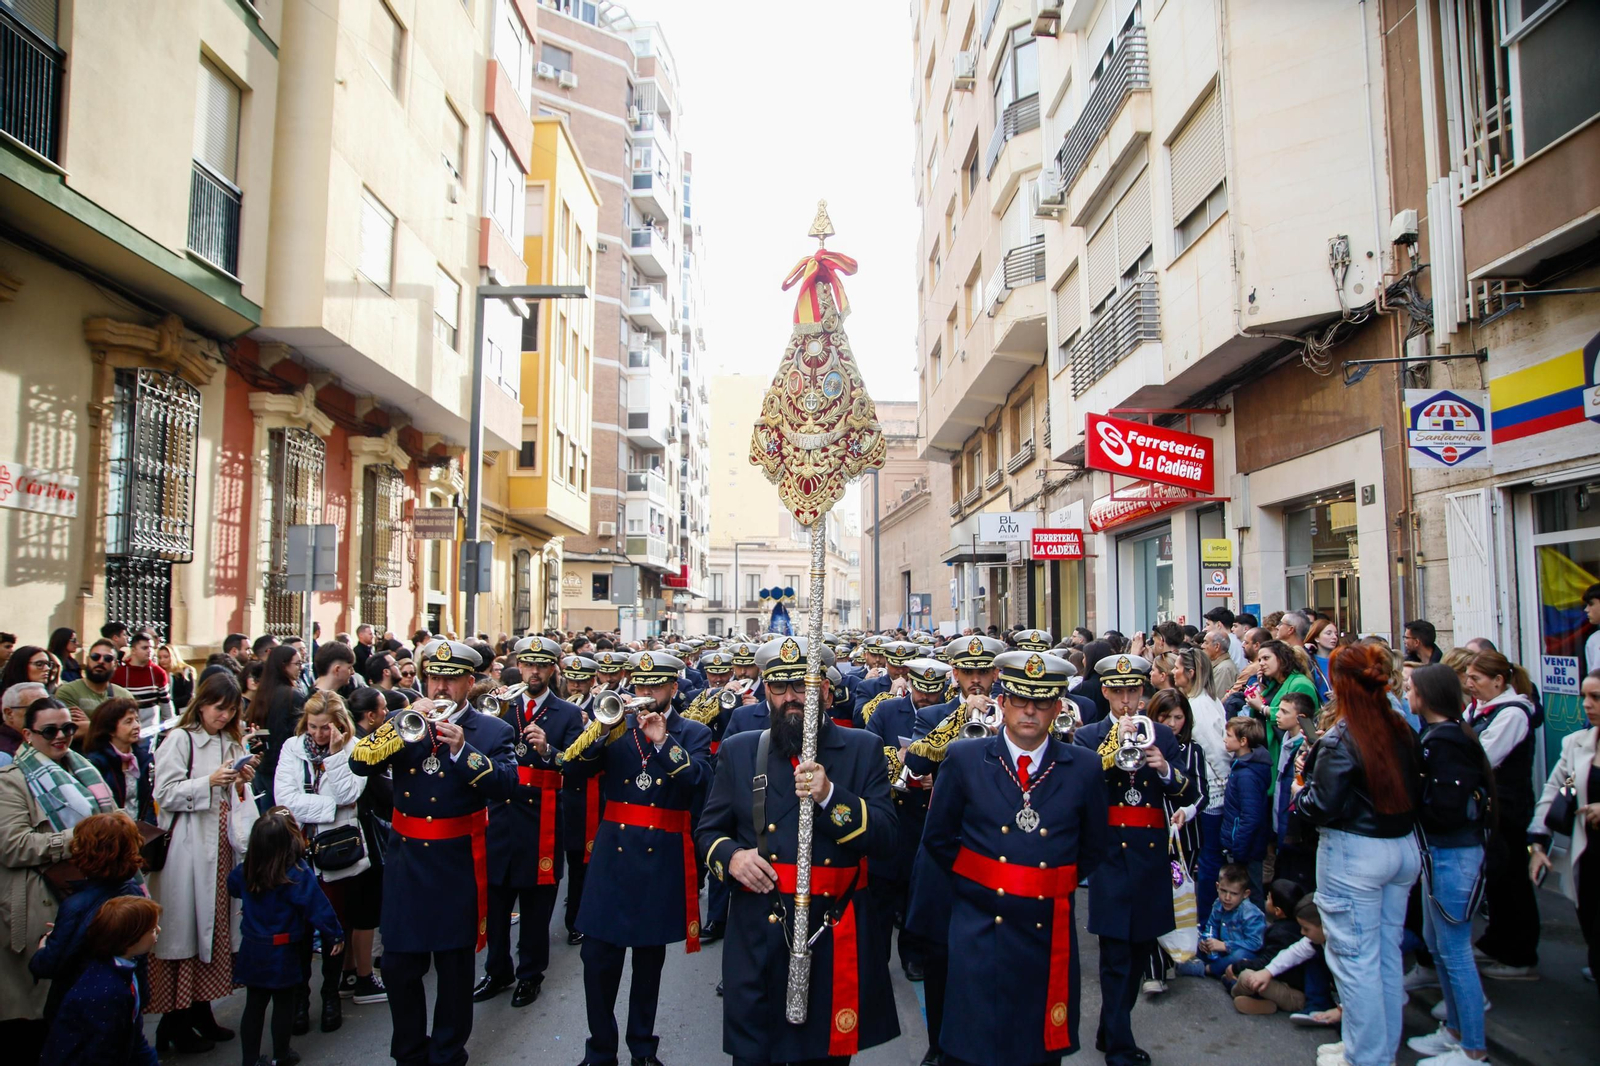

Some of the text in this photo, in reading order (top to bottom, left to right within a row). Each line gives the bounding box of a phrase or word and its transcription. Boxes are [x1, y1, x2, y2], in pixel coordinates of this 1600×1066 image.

[1415, 431, 1482, 442] Santarrita
[1127, 430, 1206, 459] Ferretería
[1139, 451, 1202, 480] La Cadena
[1181, 460, 1203, 468] centro
[15, 475, 75, 501] Cáritas
[1363, 486, 1371, 503] 9
[999, 516, 1016, 524] BL
[998, 524, 1019, 533] AM
[1035, 532, 1079, 542] FERRETERÍA
[1034, 545, 1081, 555] LA CADENA
[1543, 657, 1576, 667] VENTA
[1554, 667, 1566, 676] DE
[1546, 675, 1576, 686] HIELO
